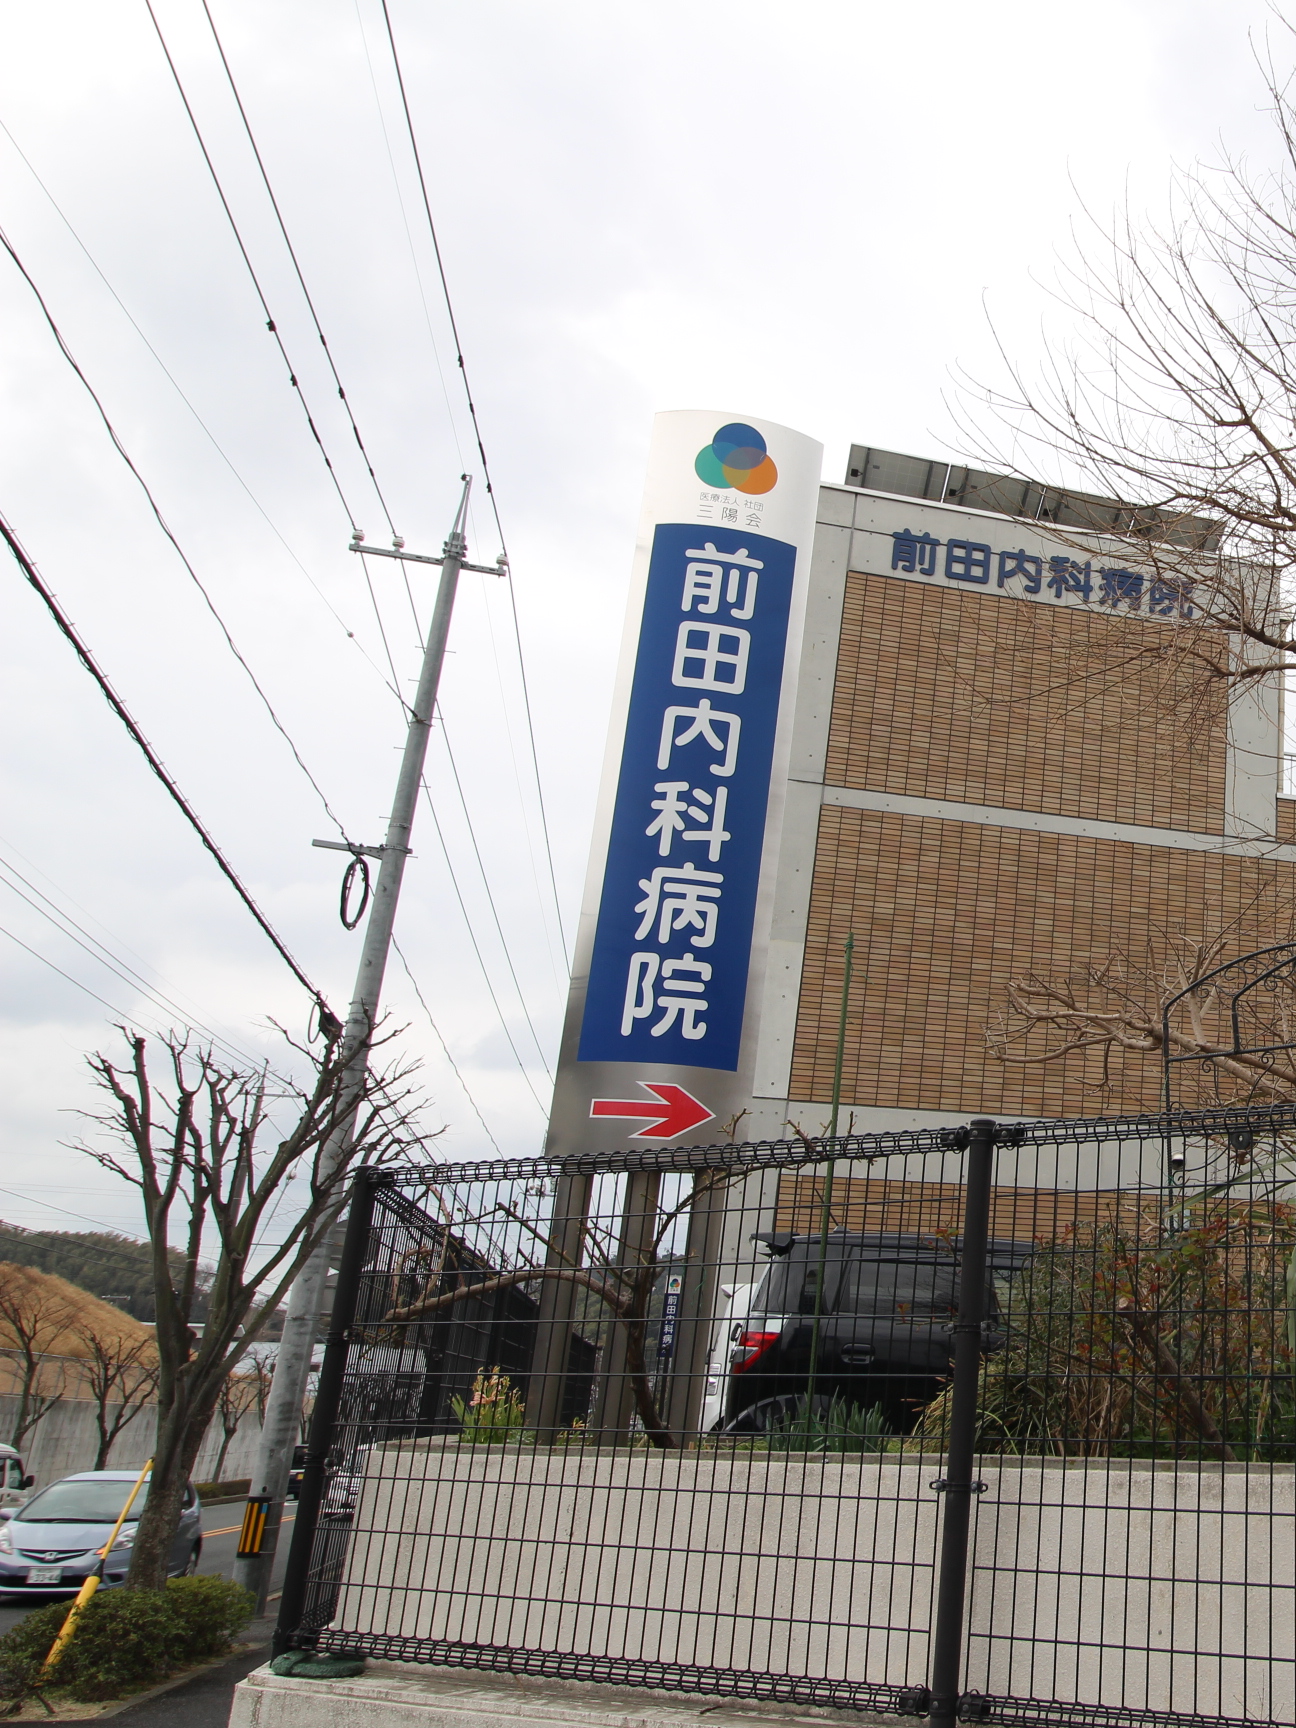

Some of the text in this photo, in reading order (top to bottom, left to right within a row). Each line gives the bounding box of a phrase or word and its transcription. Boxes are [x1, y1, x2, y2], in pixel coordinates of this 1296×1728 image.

[696, 504, 762, 528] 三陽会
[699, 492, 764, 512] 医療法人 社団
[620, 542, 764, 1040] 前田内科病院
[661, 1295, 678, 1354] 前田内科病
